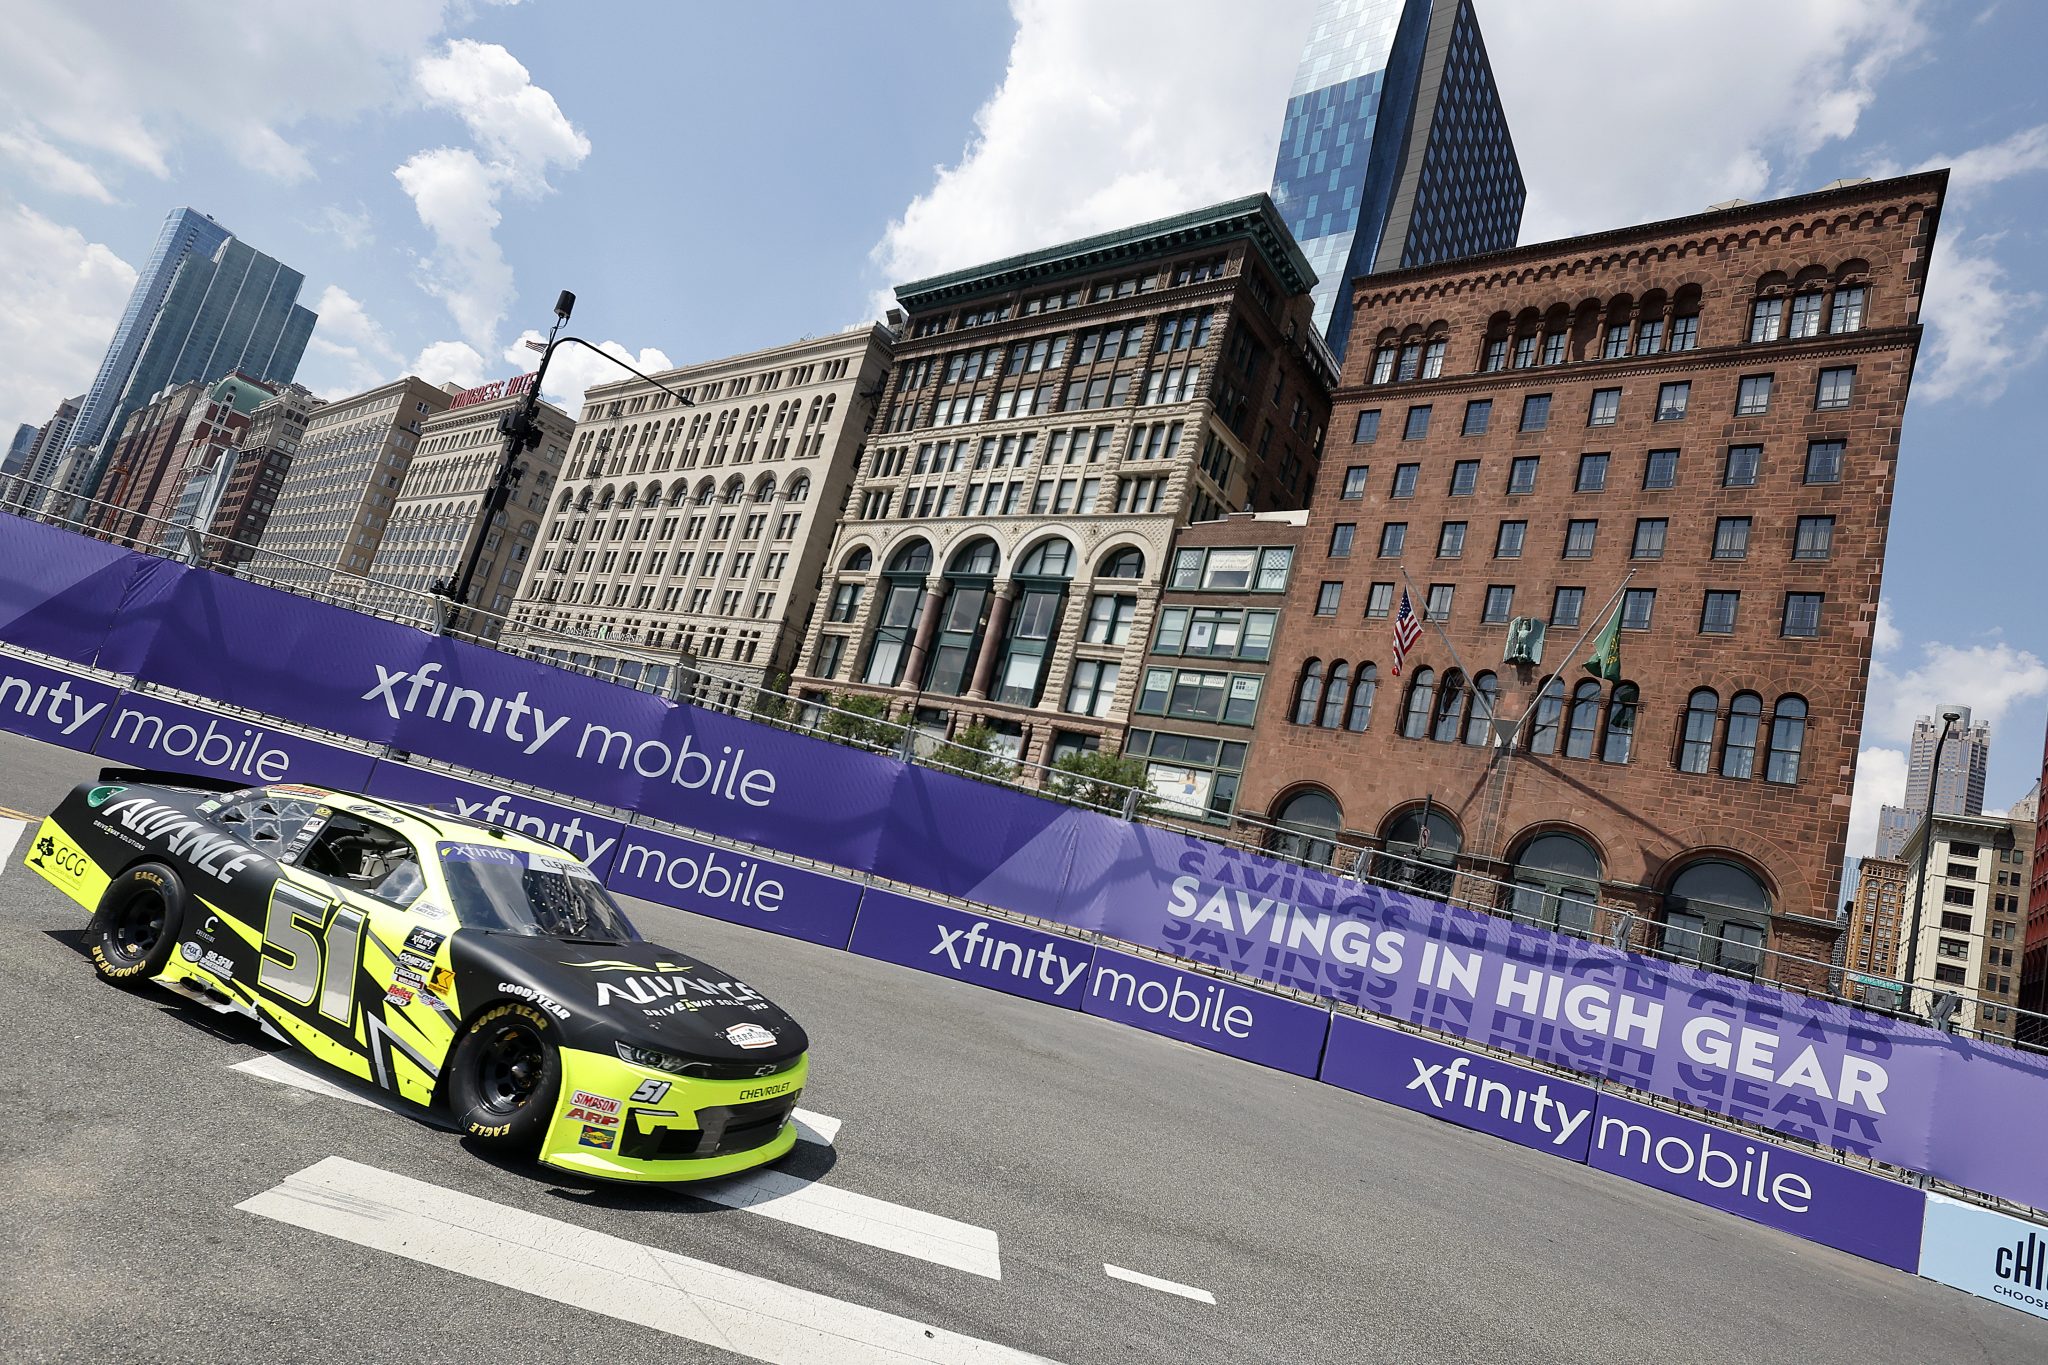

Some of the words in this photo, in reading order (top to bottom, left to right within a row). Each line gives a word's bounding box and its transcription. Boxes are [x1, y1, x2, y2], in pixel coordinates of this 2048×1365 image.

[505, 371, 541, 397] HOTE
[110, 707, 290, 781] mobile
[361, 662, 571, 755] xfinity
[576, 722, 776, 806] mobile
[119, 831, 146, 851] SOLUTIONS
[55, 847, 87, 877] GCG
[453, 844, 515, 864] xfinity
[541, 858, 592, 876] CLEMENTS
[134, 871, 164, 887] EAGLE
[619, 843, 785, 912] mobile
[187, 944, 200, 956] FOX
[257, 877, 370, 1028] 51
[411, 934, 437, 950] xfinity
[92, 945, 146, 978] GOODYEAR
[398, 952, 433, 970] COMETIC
[395, 967, 422, 982] LINCOLN
[929, 921, 1088, 995] xfinity
[1092, 965, 1254, 1039] mobile
[384, 994, 408, 1007] MSD
[387, 984, 415, 1000] Holley
[498, 982, 571, 1020] GOODYEAR
[596, 975, 765, 1007] ALLIANCE
[1167, 876, 1405, 976] SAVINGS
[1417, 939, 1483, 999] IN
[1496, 963, 1664, 1050] HIGH
[1681, 1016, 1889, 1115] GEAR
[470, 1003, 549, 1034] GOODYEAR
[643, 999, 715, 1017] DRIVEAWAY
[716, 999, 769, 1011] SOLUONS
[574, 1093, 618, 1113] SIMPSON
[630, 1078, 672, 1104] 51
[739, 1081, 792, 1100] CHEVROLET
[469, 1122, 511, 1137] EAGLE
[565, 1107, 620, 1126] ARP
[1406, 1056, 1591, 1146] xfinity
[1597, 1114, 1813, 1214] mobile
[1995, 1232, 2048, 1292] CHI
